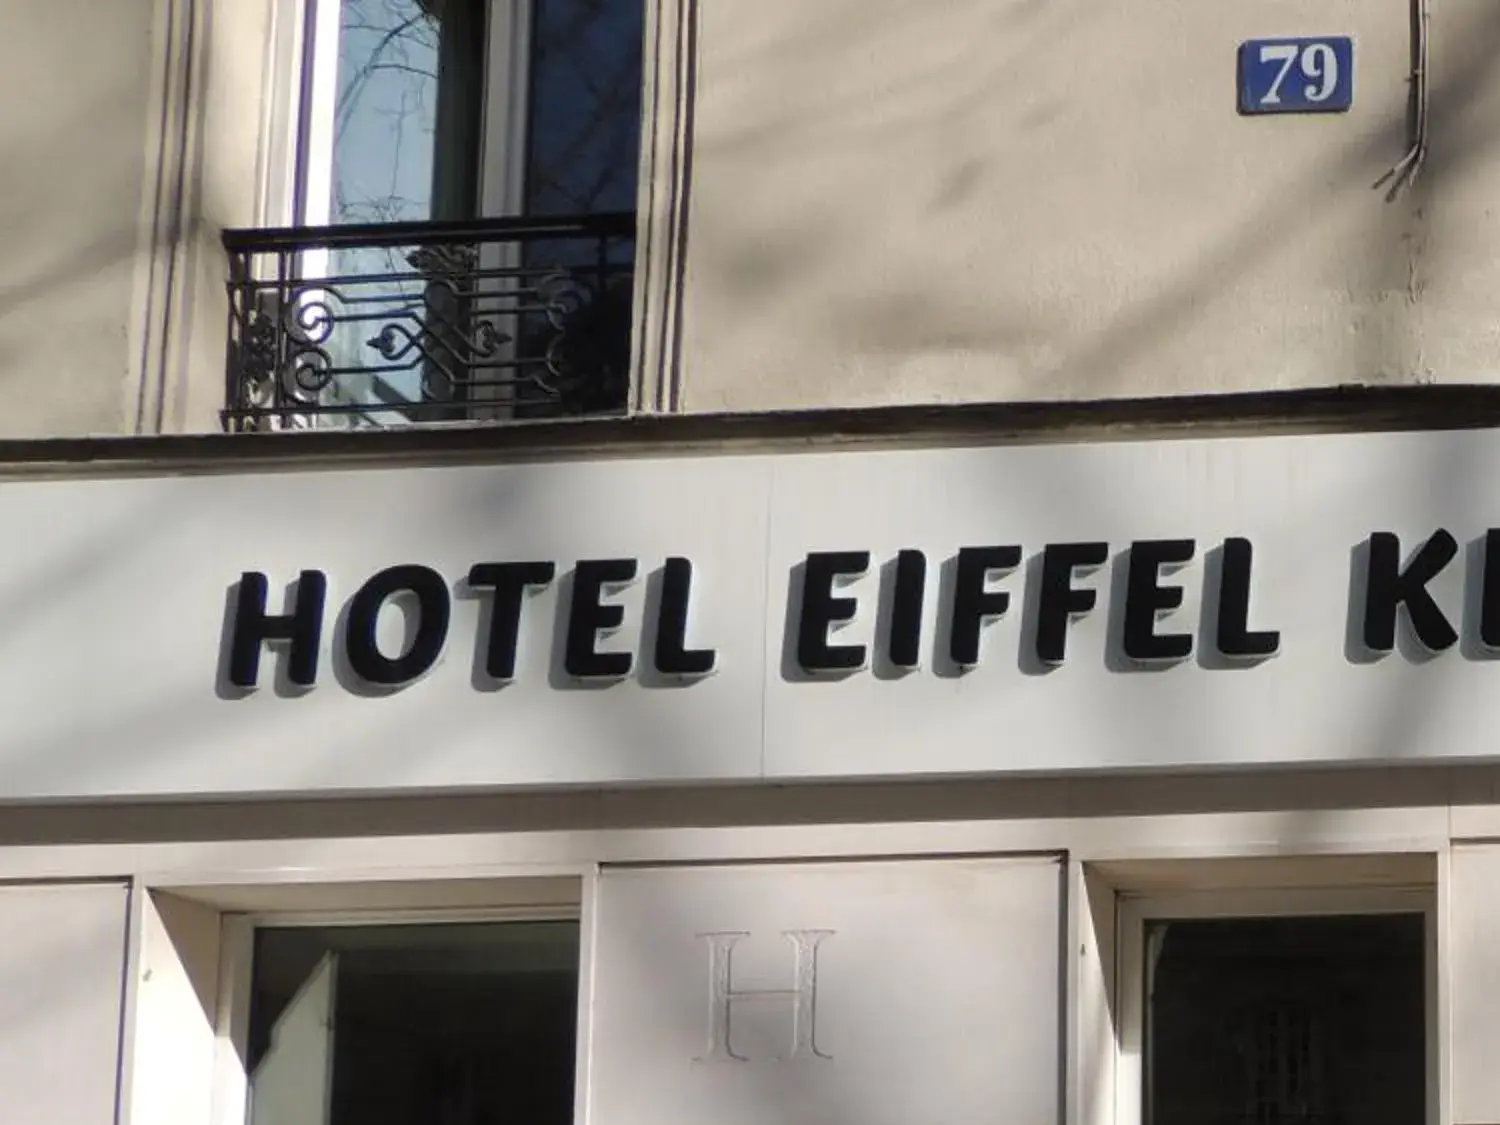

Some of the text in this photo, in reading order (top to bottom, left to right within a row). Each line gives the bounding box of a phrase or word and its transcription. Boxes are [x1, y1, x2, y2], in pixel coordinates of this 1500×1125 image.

[1260, 43, 1338, 104] 79
[226, 557, 716, 689] HOTEL
[794, 537, 1280, 671] EIFFEL
[692, 929, 836, 1062] H
